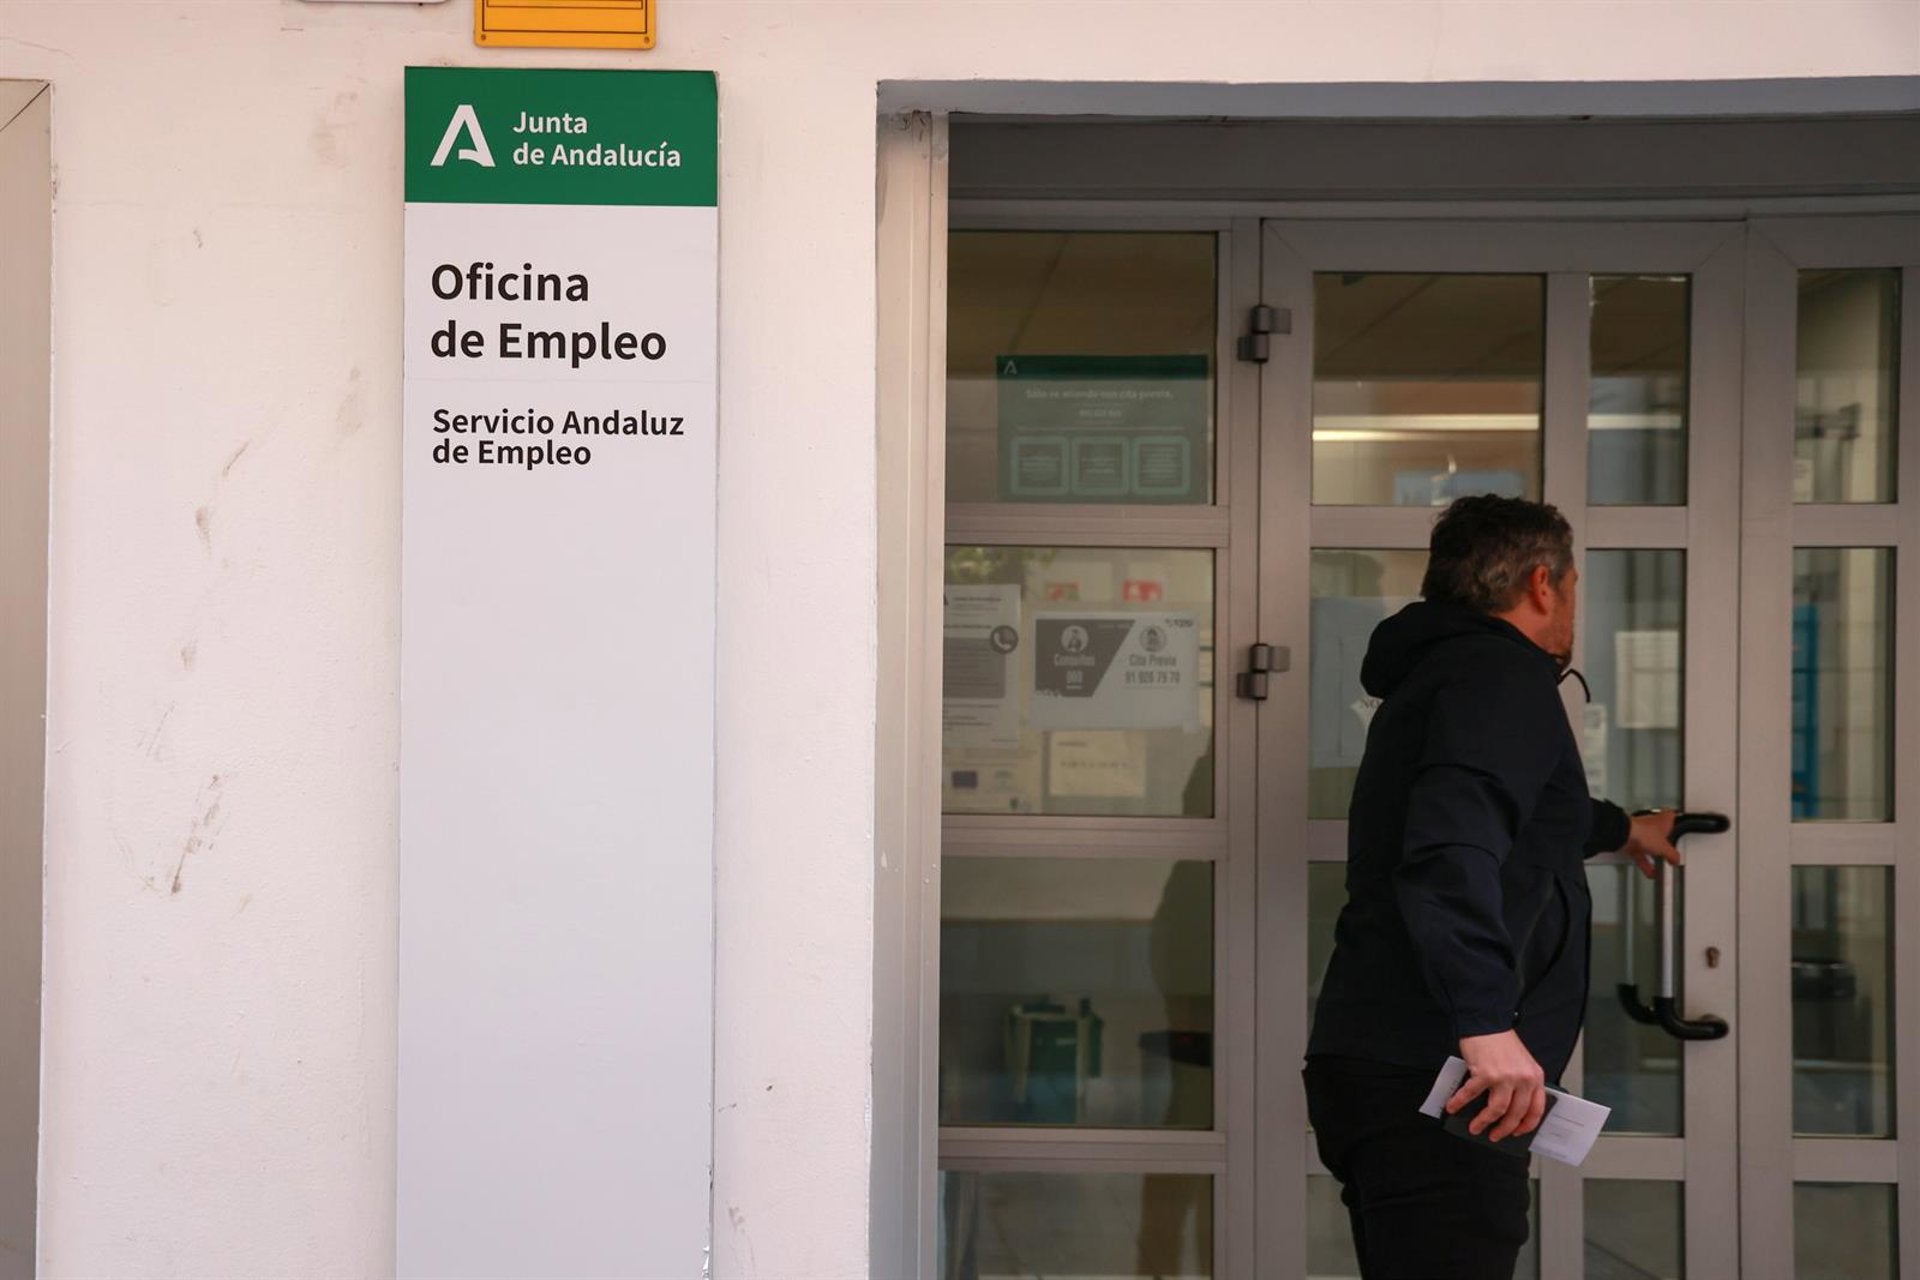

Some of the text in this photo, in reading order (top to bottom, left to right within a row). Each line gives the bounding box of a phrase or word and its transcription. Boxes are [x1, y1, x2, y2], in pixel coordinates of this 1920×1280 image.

[513, 111, 587, 134] Junta
[513, 141, 681, 168] de Andalucía
[431, 261, 589, 302] Oficina
[431, 319, 667, 369] de Empleo
[434, 408, 684, 436] Servicio Andaluz
[433, 437, 592, 471] de Empleo
[1129, 653, 1147, 667] Cita
